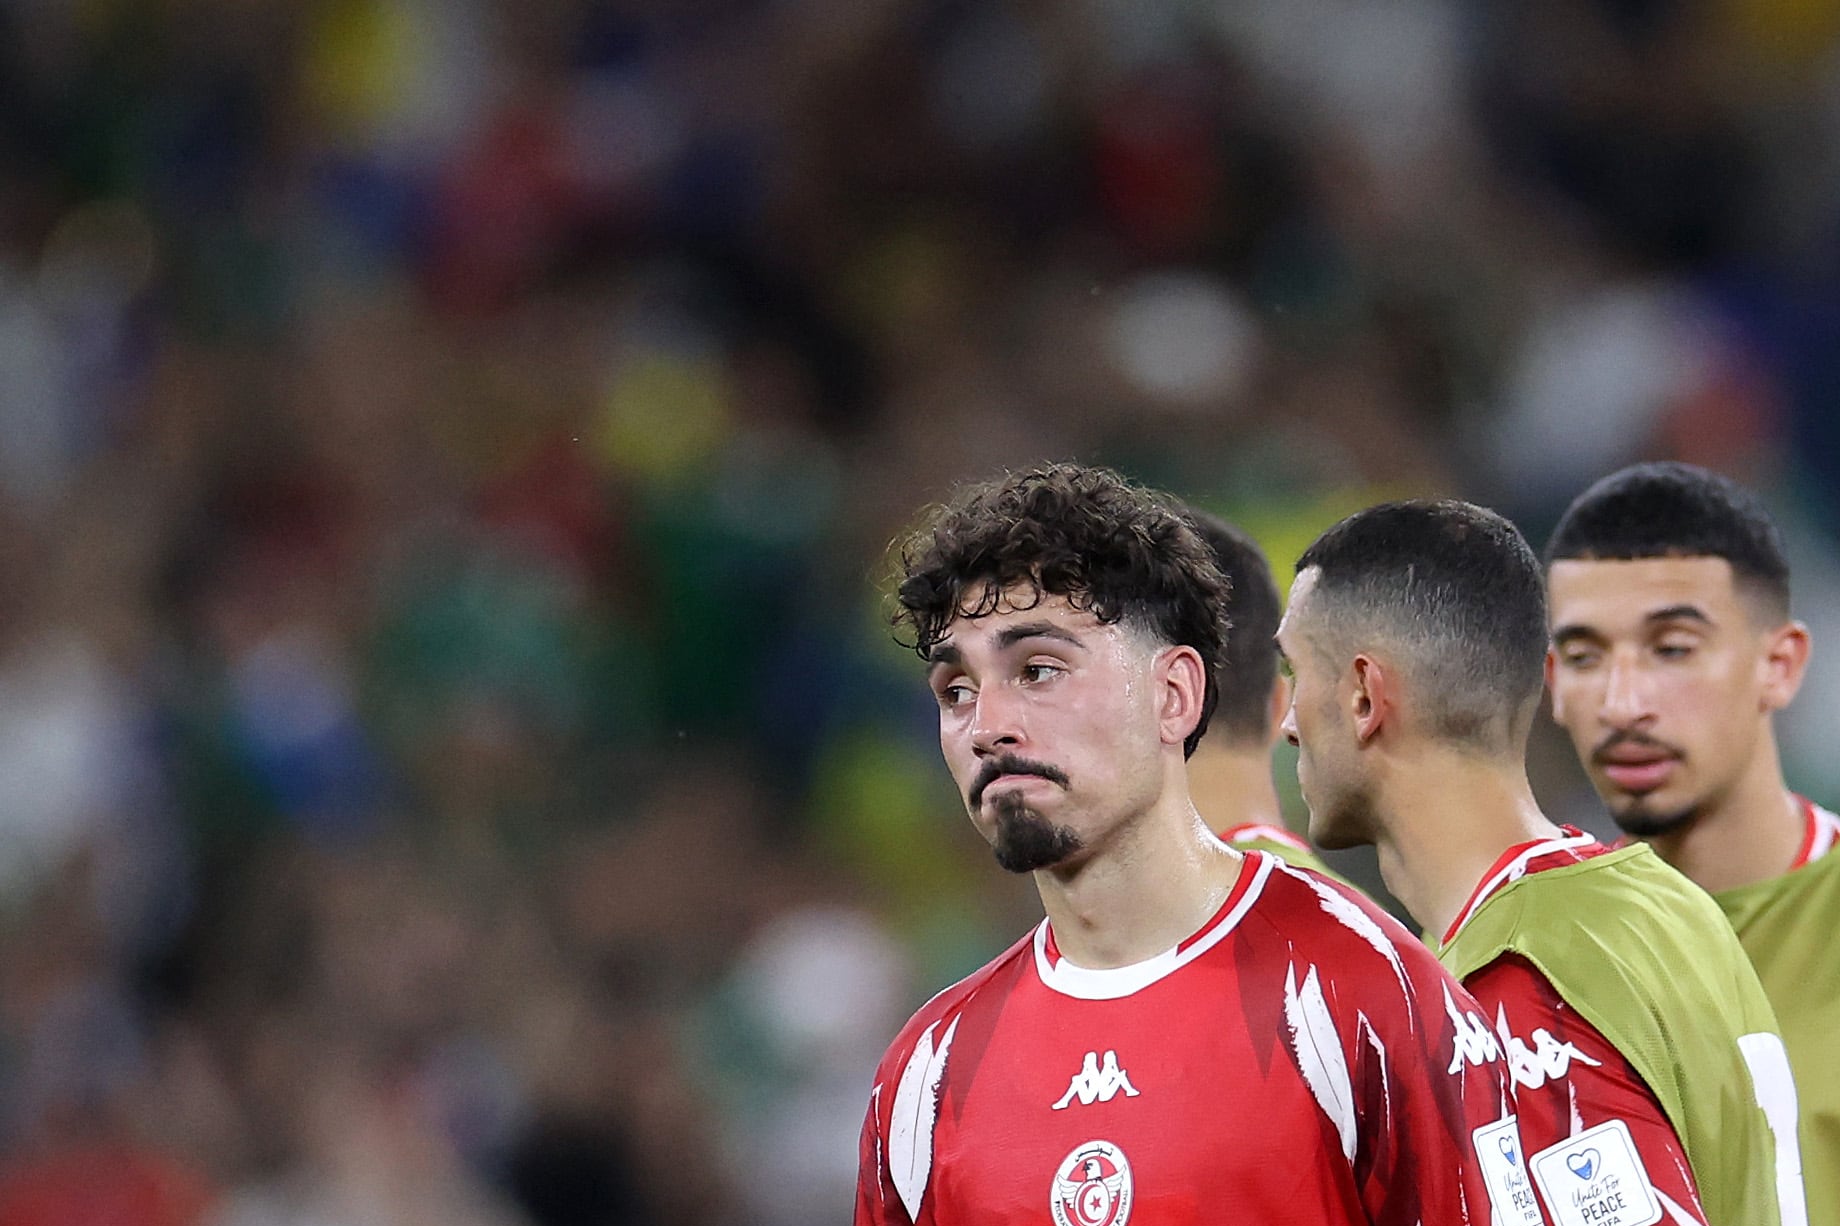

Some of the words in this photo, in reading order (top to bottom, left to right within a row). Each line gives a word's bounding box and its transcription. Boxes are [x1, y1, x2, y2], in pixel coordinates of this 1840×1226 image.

[1571, 1183, 1602, 1208] Unite
[1602, 1174, 1622, 1194] For
[1581, 1192, 1627, 1224] PEACE
